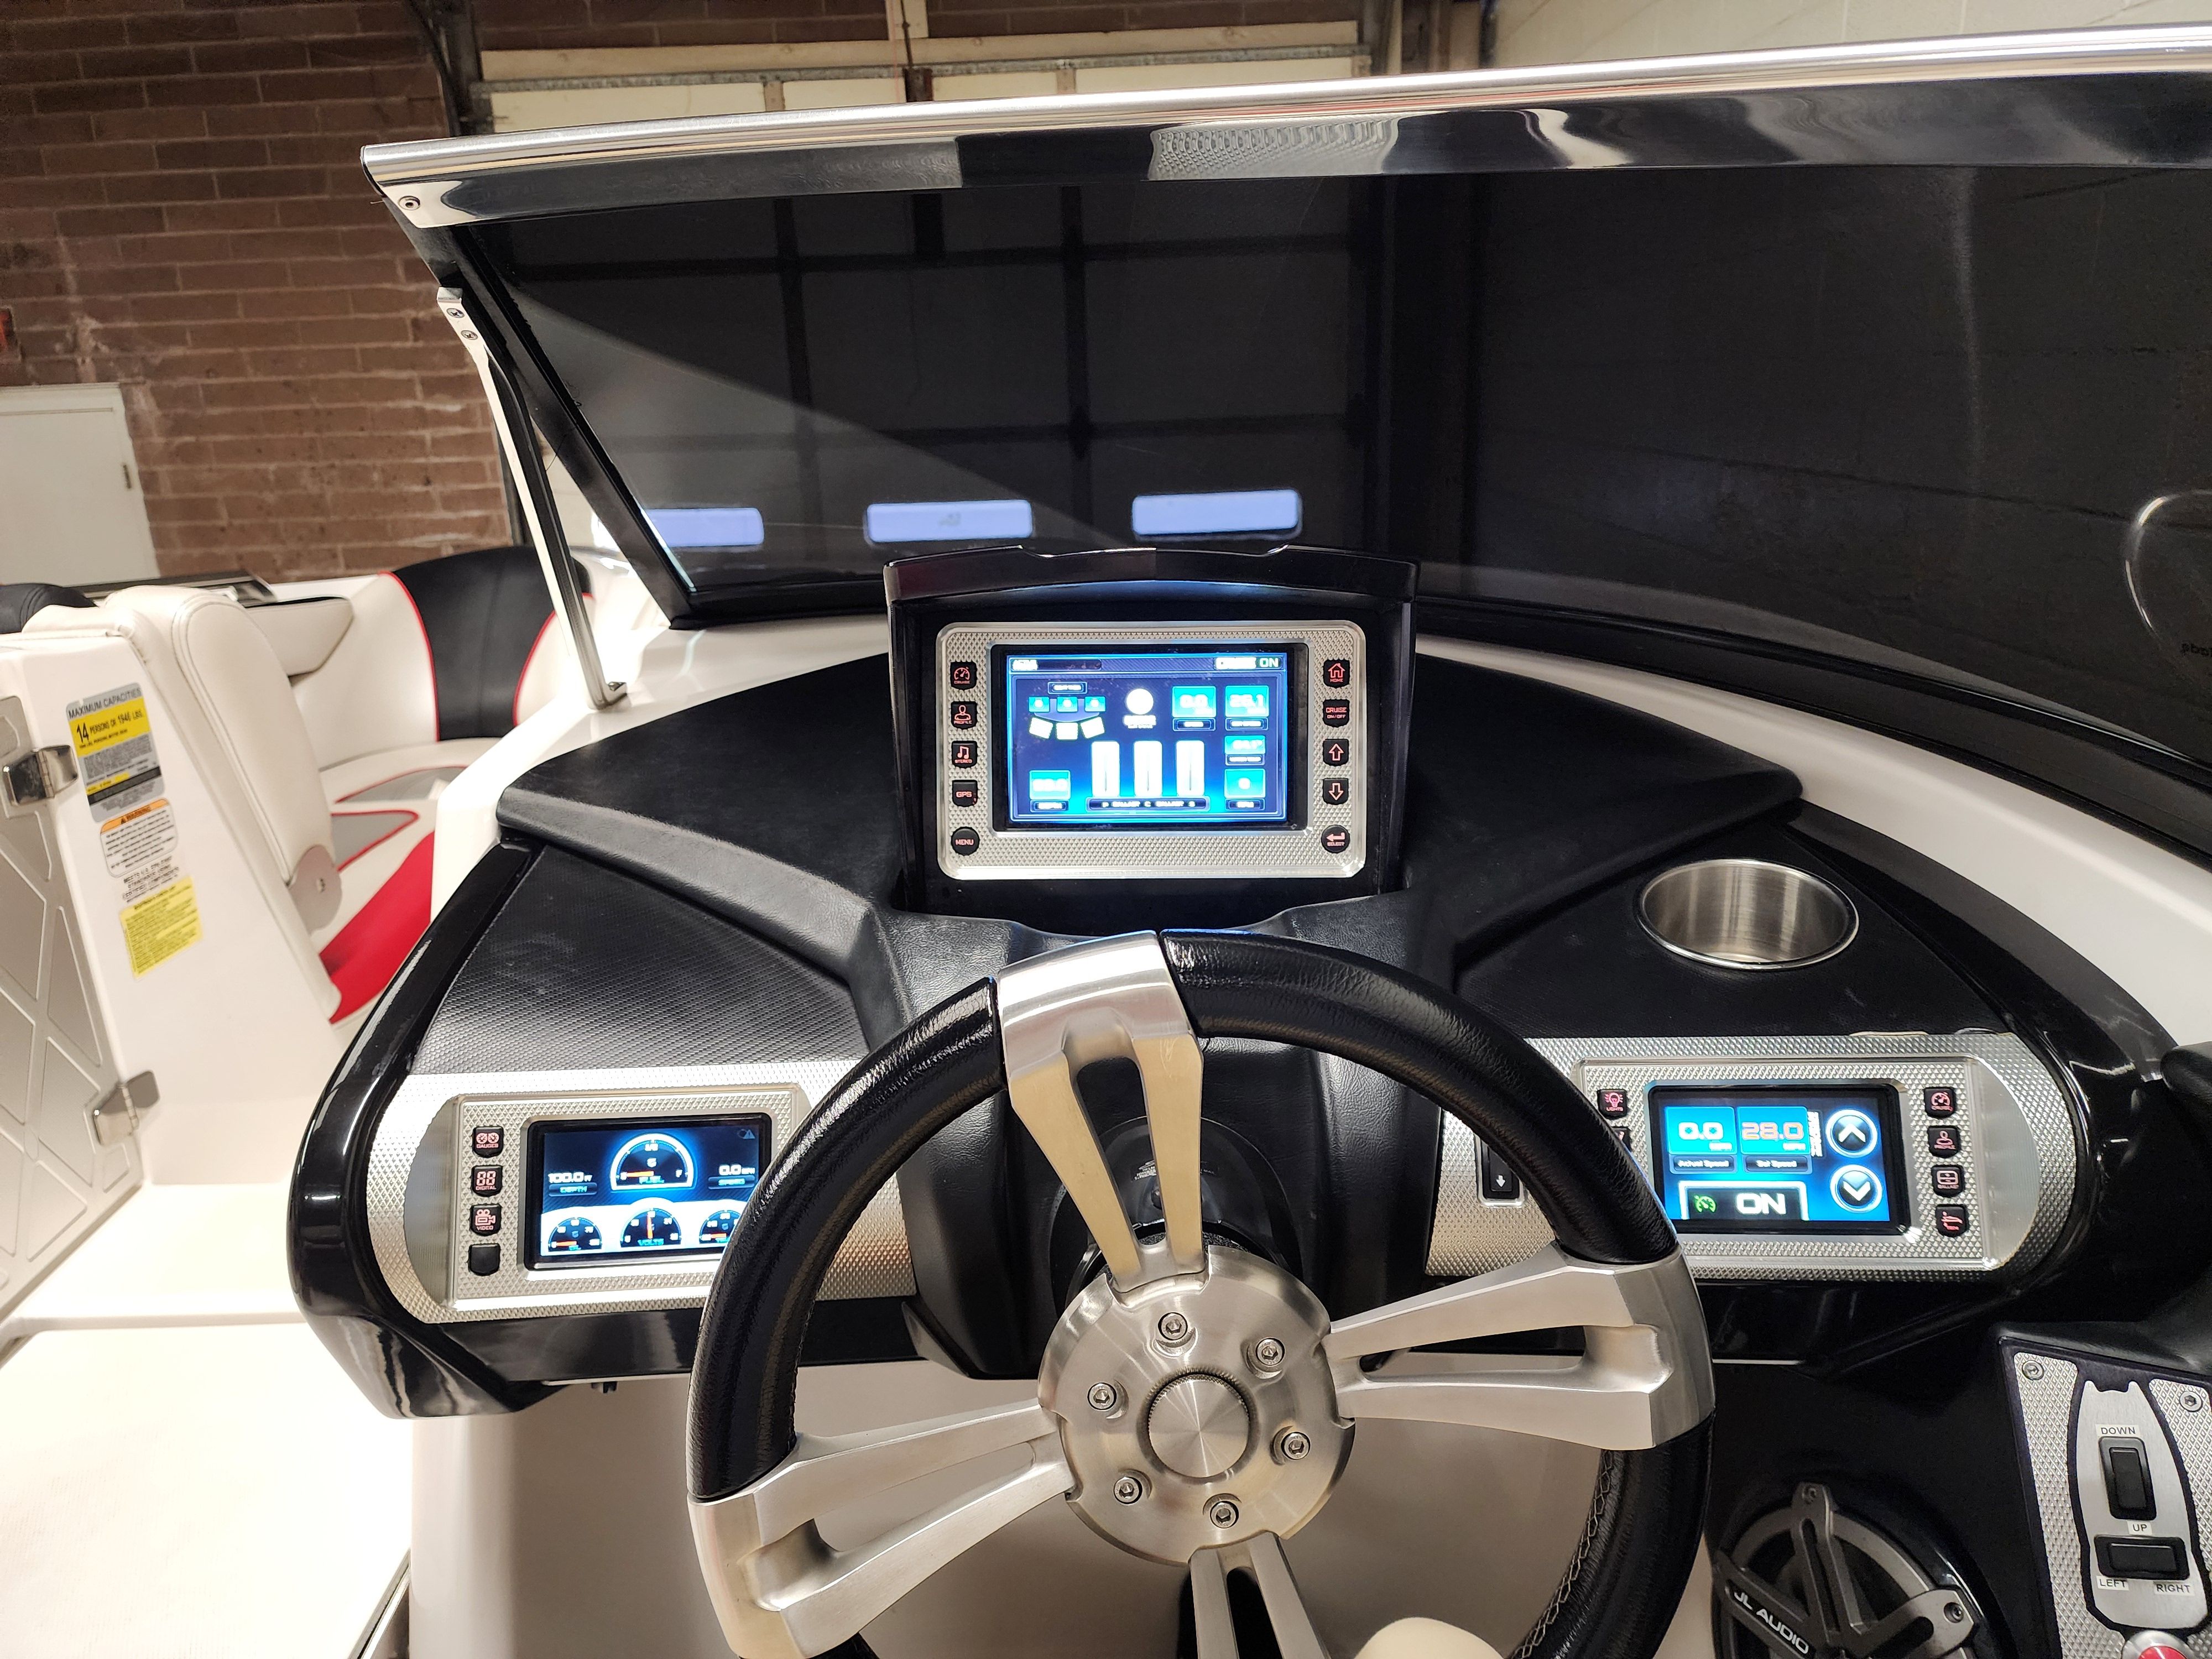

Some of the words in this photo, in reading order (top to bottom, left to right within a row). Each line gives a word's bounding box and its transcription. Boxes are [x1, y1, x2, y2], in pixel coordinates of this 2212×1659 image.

[1260, 658, 1279, 667] ON
[69, 701, 102, 718] MAXIMUM
[103, 688, 142, 707] CAPACITIES
[76, 722, 89, 743] 14
[1678, 1122, 1724, 1140] 0.0
[1742, 1121, 1804, 1140] 28.0
[548, 1172, 584, 1183] 100.0
[719, 1164, 741, 1176] 0.0
[1736, 1193, 1786, 1214] ON
[2099, 1579, 2127, 1588] LEFT
[2157, 1584, 2190, 1593] RIGHT
[1734, 1593, 1753, 1610] JL
[1756, 1609, 1809, 1654] AUDIO
